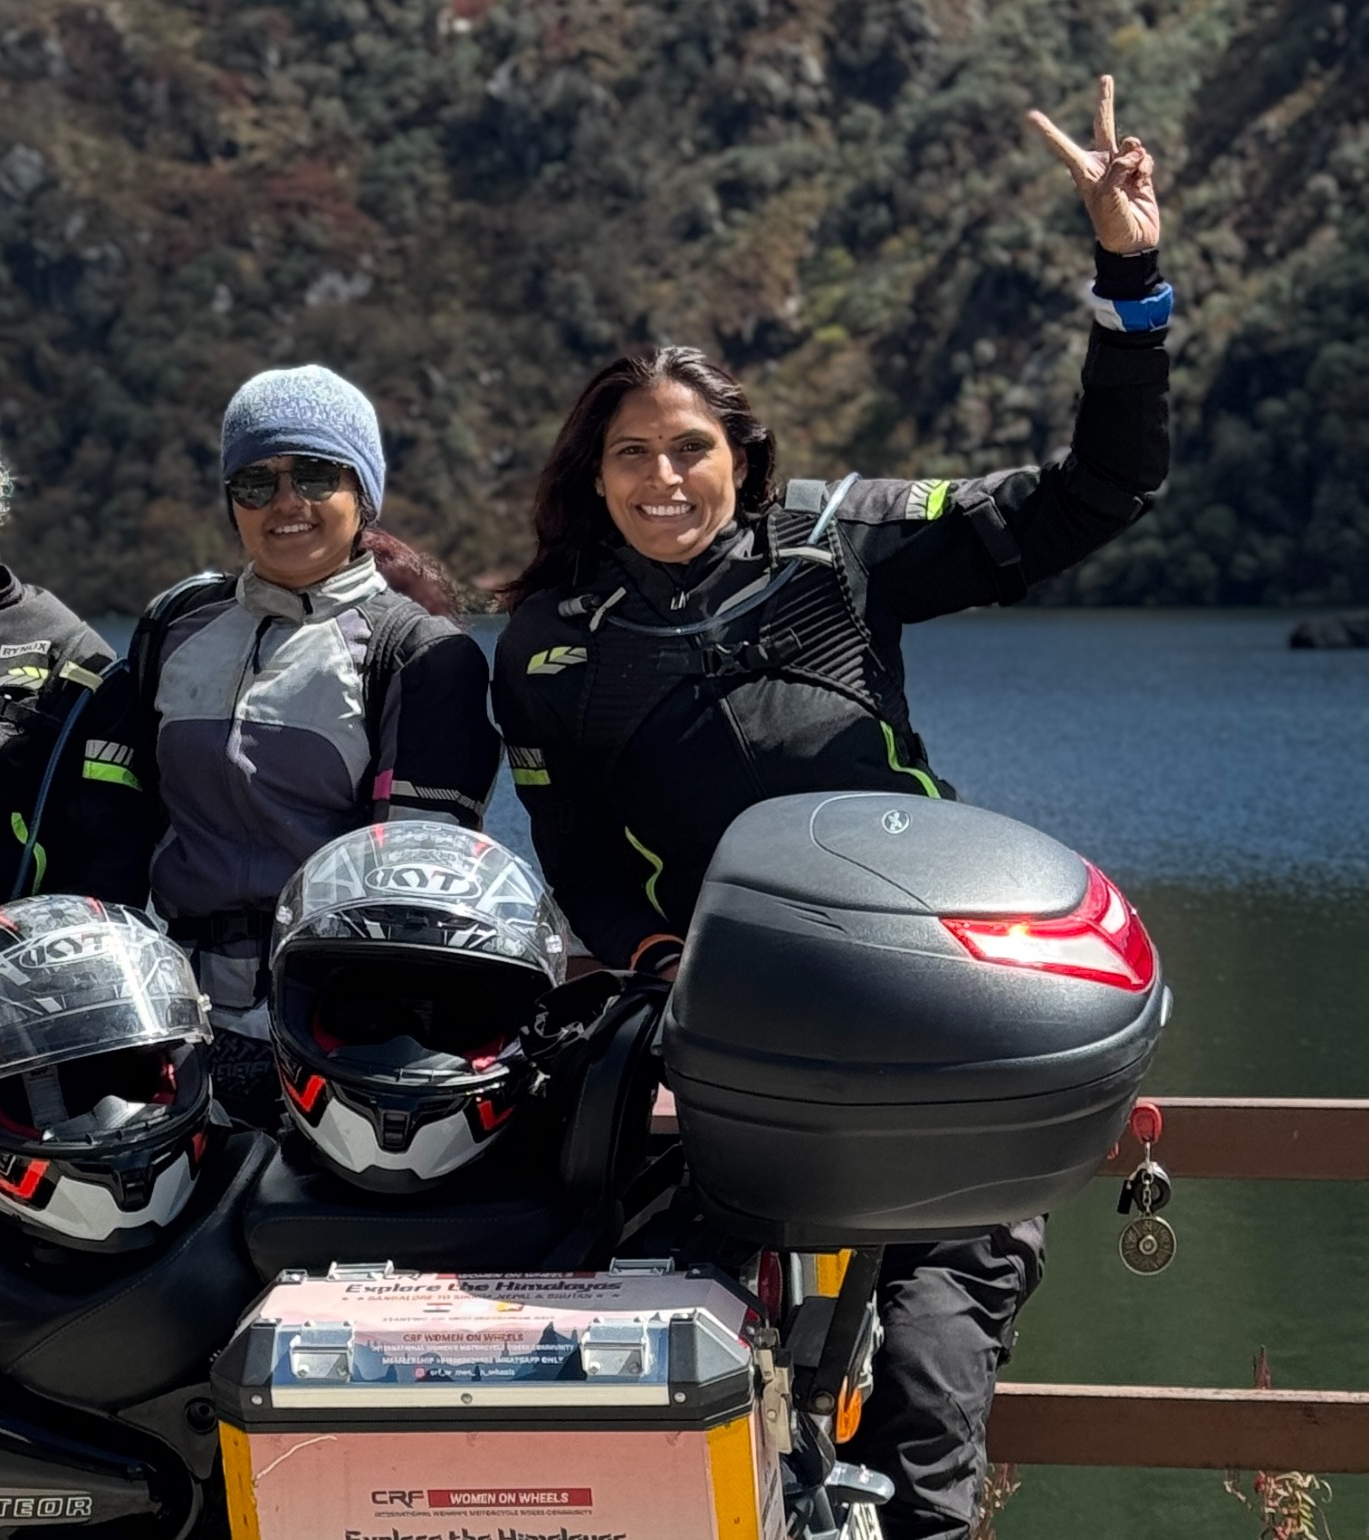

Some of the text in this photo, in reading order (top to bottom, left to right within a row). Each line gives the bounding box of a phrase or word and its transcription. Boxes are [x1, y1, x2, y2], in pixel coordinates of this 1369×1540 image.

[367, 867, 466, 892] KYT
[21, 931, 110, 966] KYT
[345, 1280, 624, 1295] Explore the Himalayas
[403, 1333, 524, 1342] CRF WOMEN ON WHEELS
[371, 1490, 569, 1509] CRF WOMEN ON WHEELS
